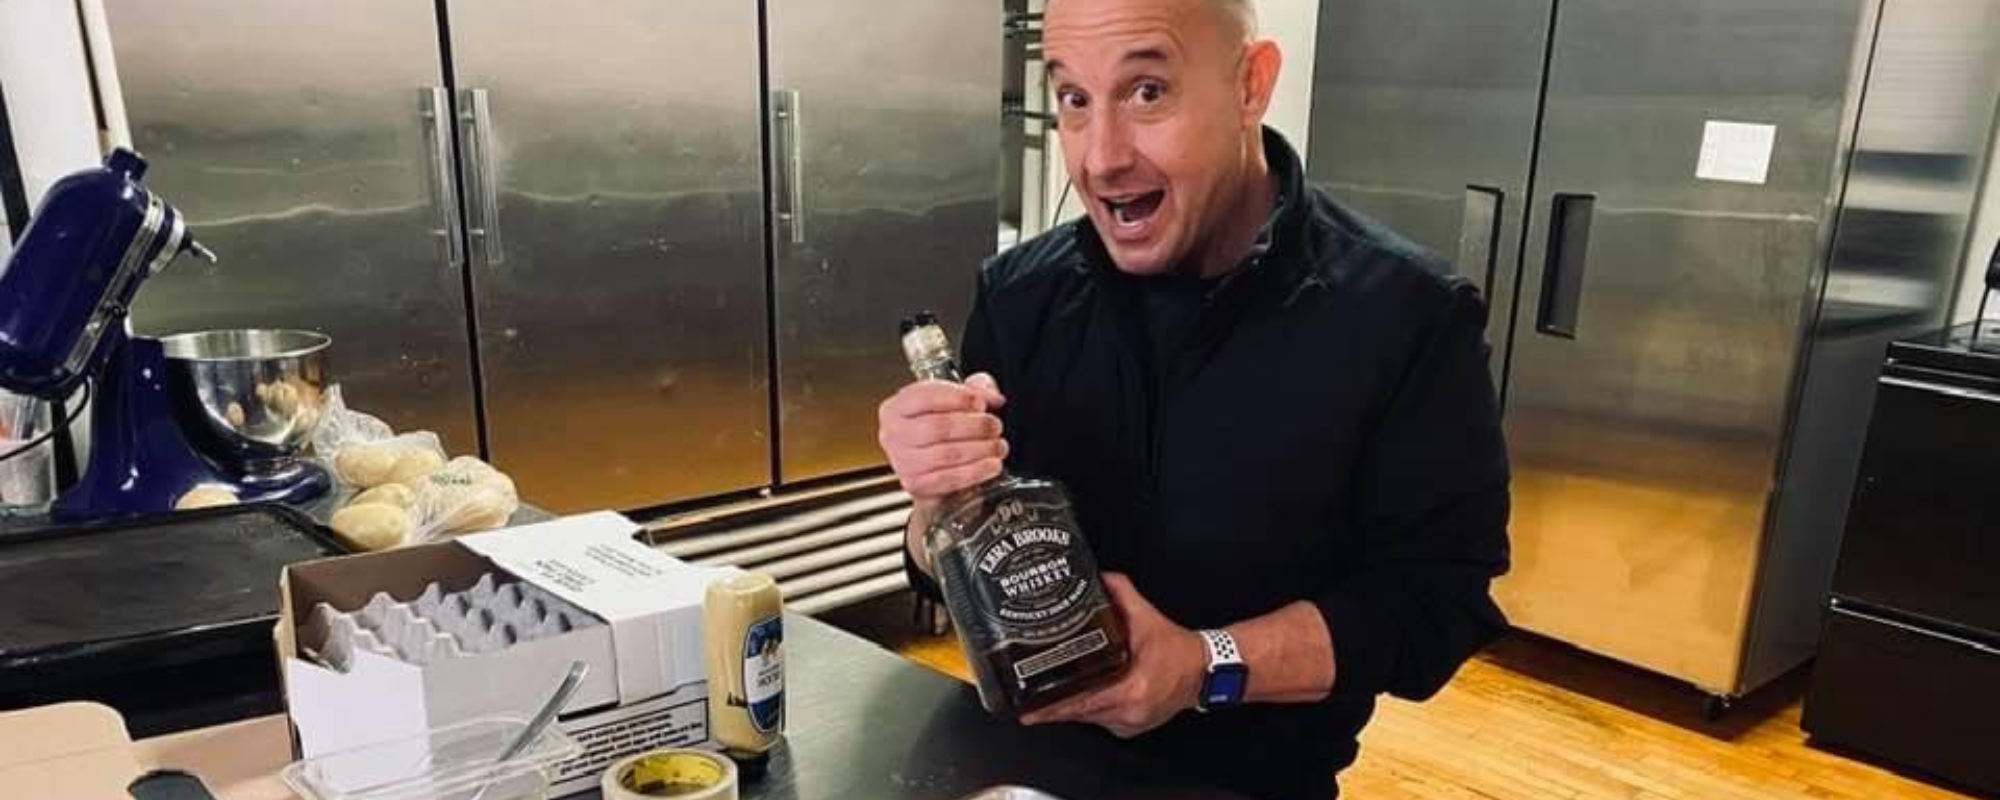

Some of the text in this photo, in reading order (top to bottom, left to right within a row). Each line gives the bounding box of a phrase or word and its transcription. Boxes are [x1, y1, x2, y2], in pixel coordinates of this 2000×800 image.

[1012, 527, 1070, 547] BROOKS
[1000, 557, 1067, 587] BOURBON
[1004, 565, 1070, 597] WHISKEY
